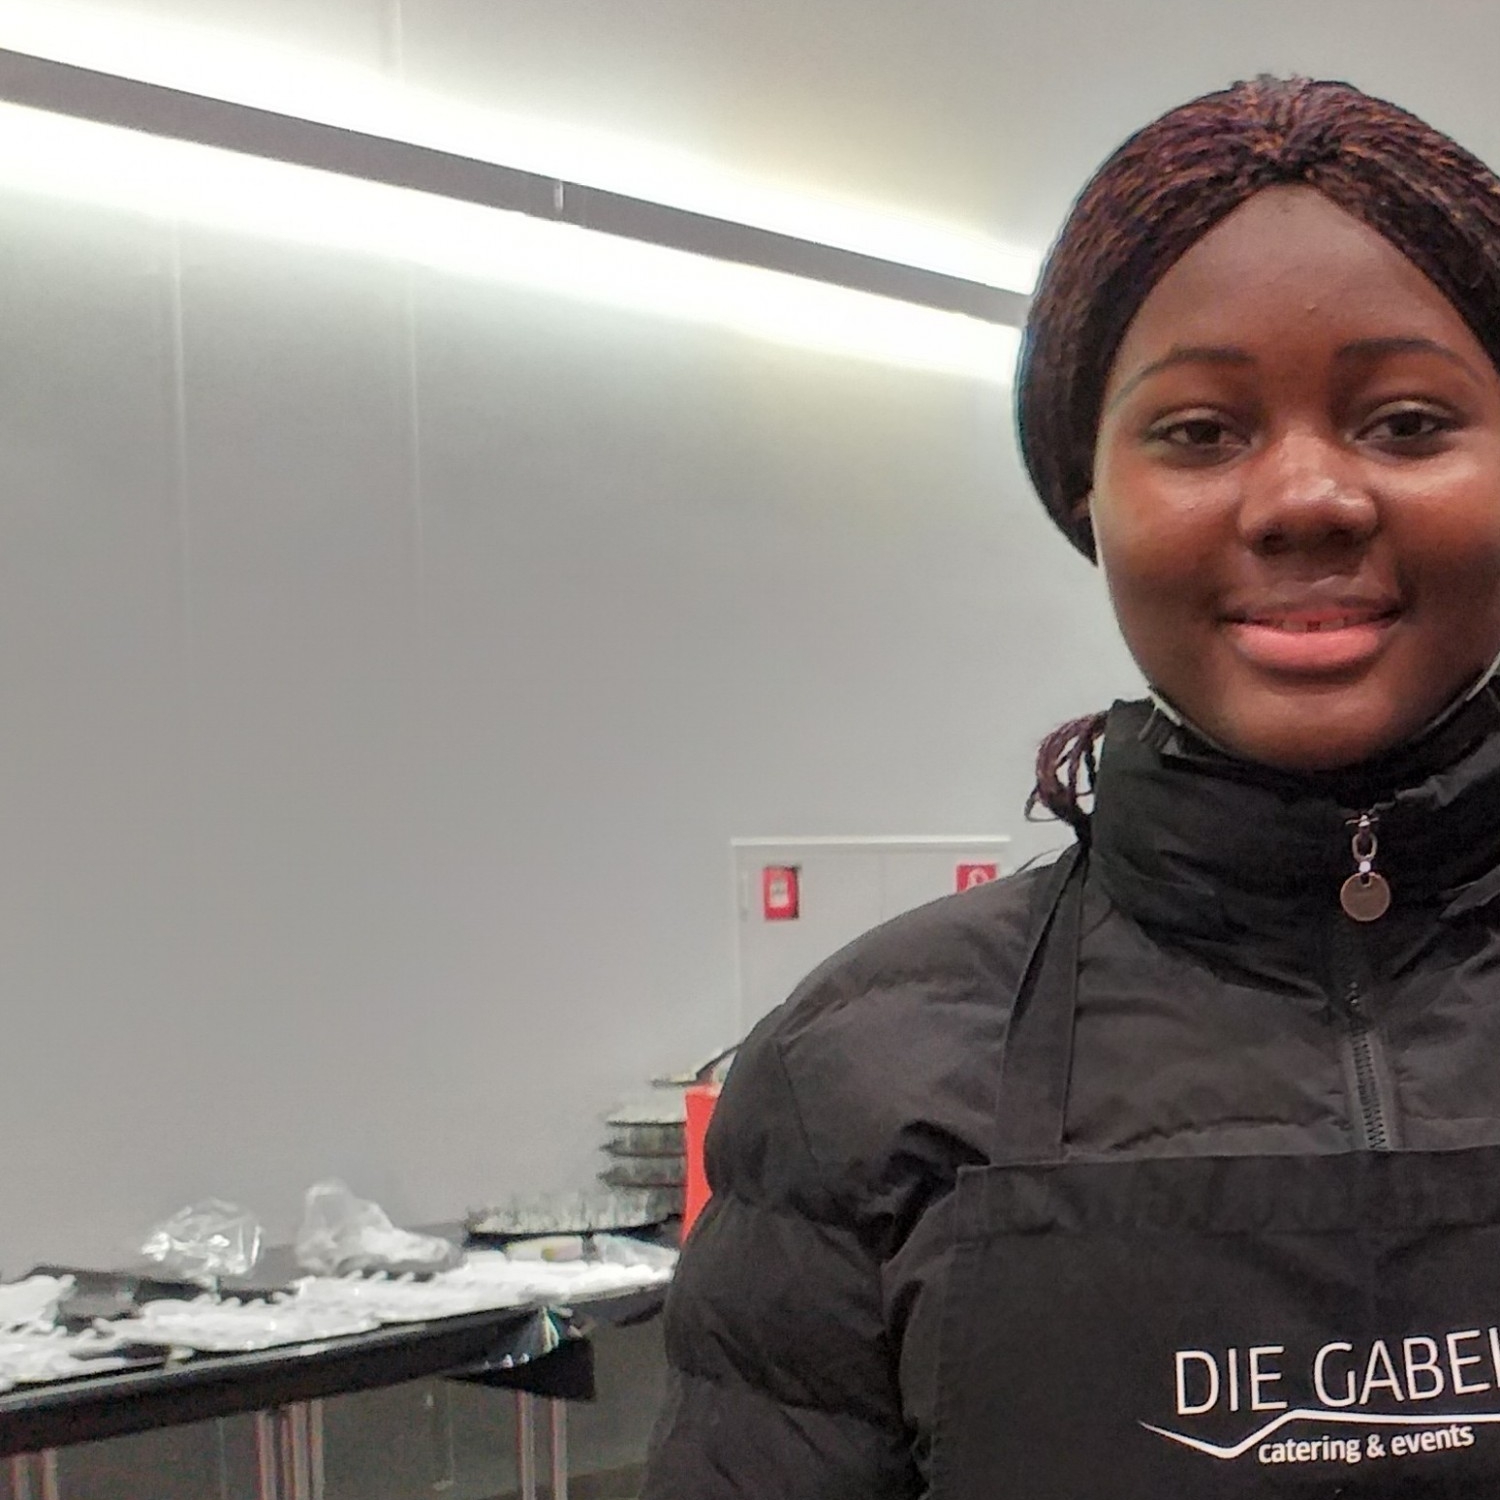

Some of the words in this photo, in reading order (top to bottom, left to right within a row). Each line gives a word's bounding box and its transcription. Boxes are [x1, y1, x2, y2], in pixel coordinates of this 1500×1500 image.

[1175, 1345, 1288, 1415] DIE
[1258, 1434, 1361, 1464] catering
[1366, 1434, 1386, 1458] &
[1391, 1423, 1475, 1456] events
